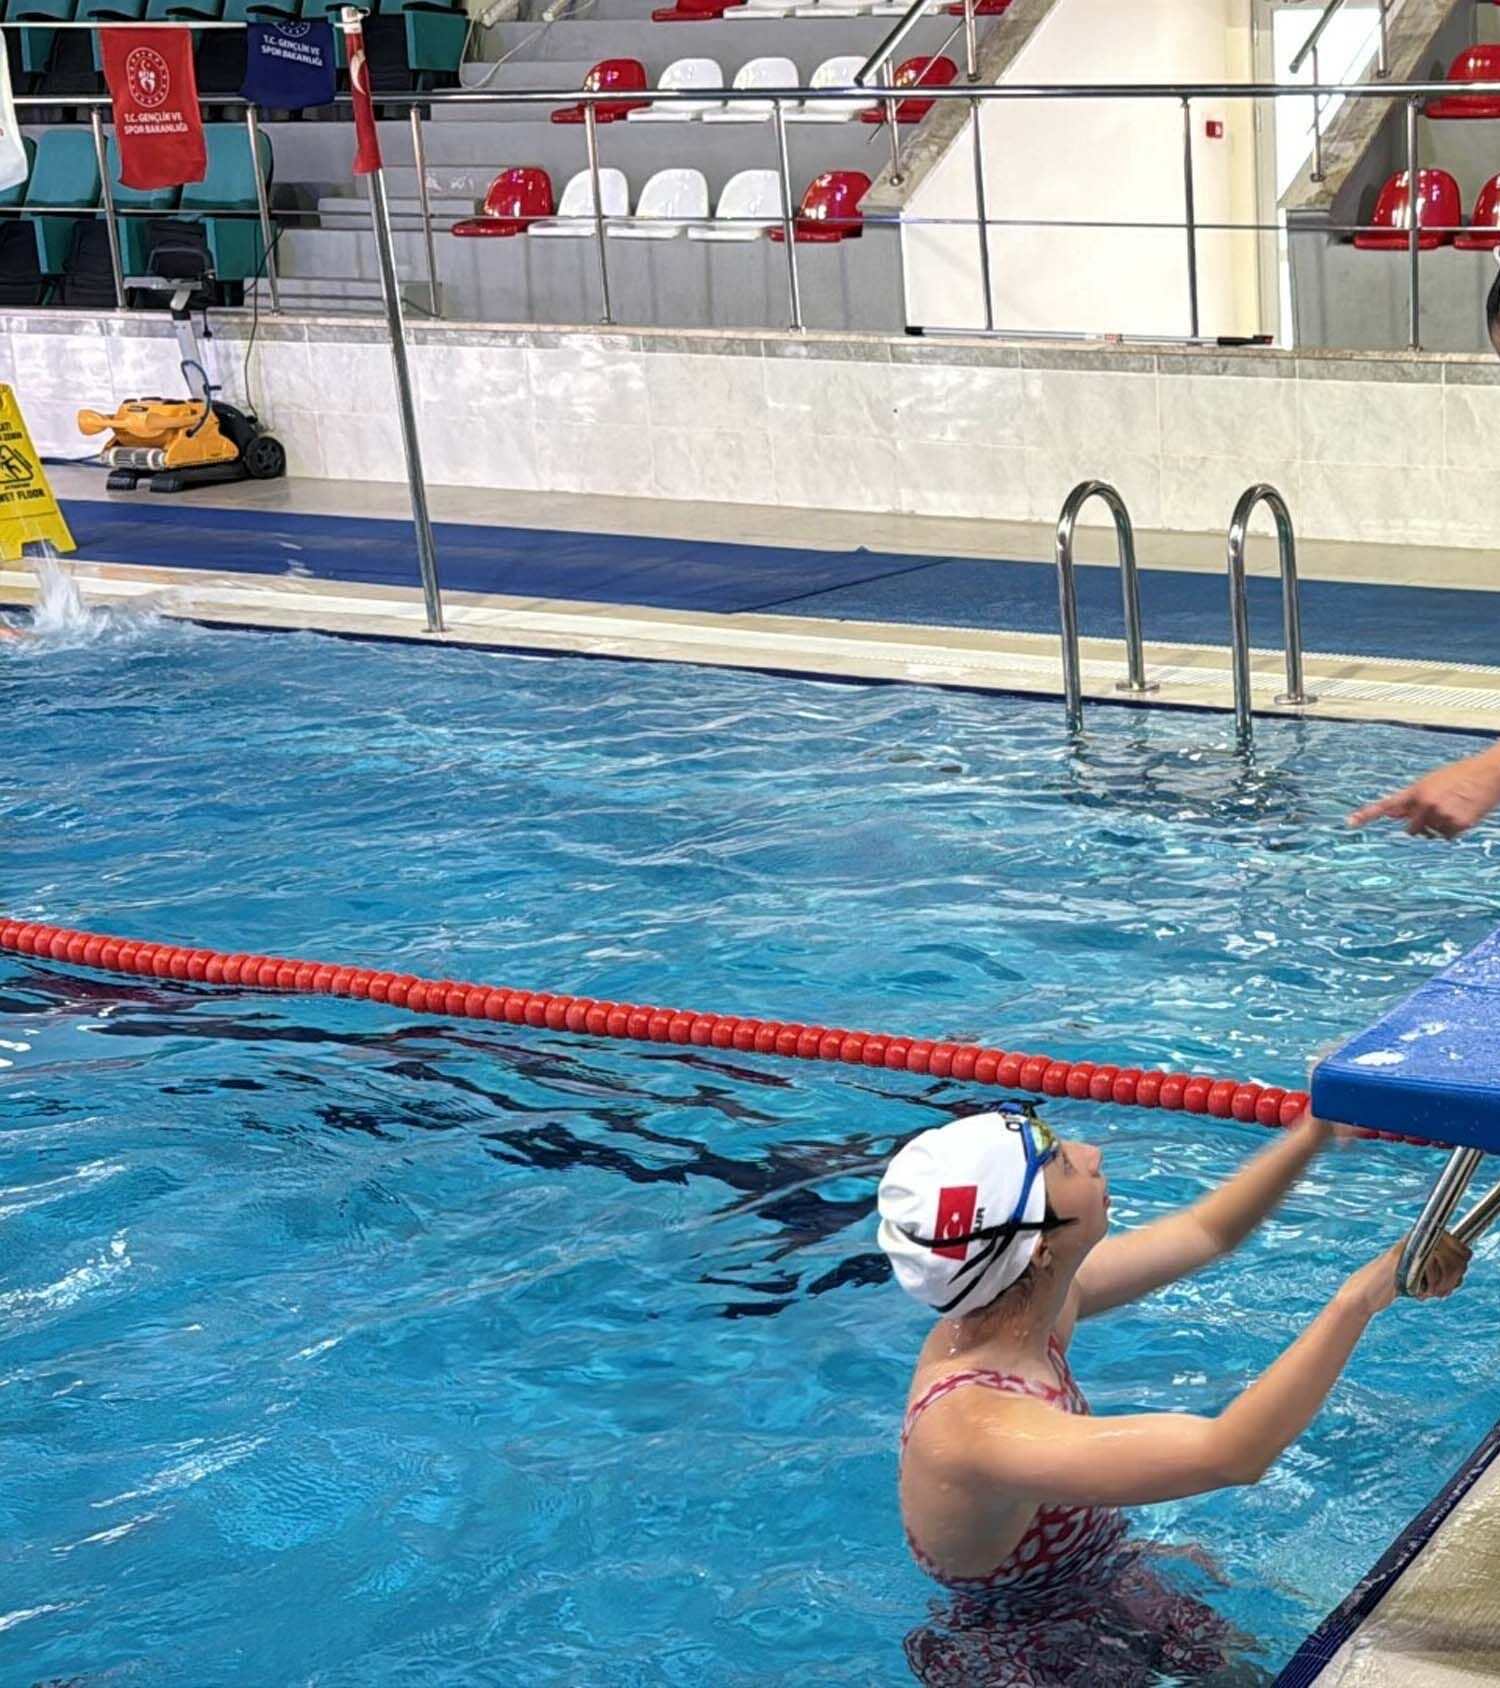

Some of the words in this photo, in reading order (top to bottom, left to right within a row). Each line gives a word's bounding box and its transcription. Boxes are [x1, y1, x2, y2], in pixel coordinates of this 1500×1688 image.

[261, 44, 282, 56] SPOR
[263, 34, 277, 45] T.C.
[310, 46, 320, 56] VE
[124, 112, 137, 123] T.C.
[171, 112, 182, 121] VE
[124, 124, 145, 135] SPOR
